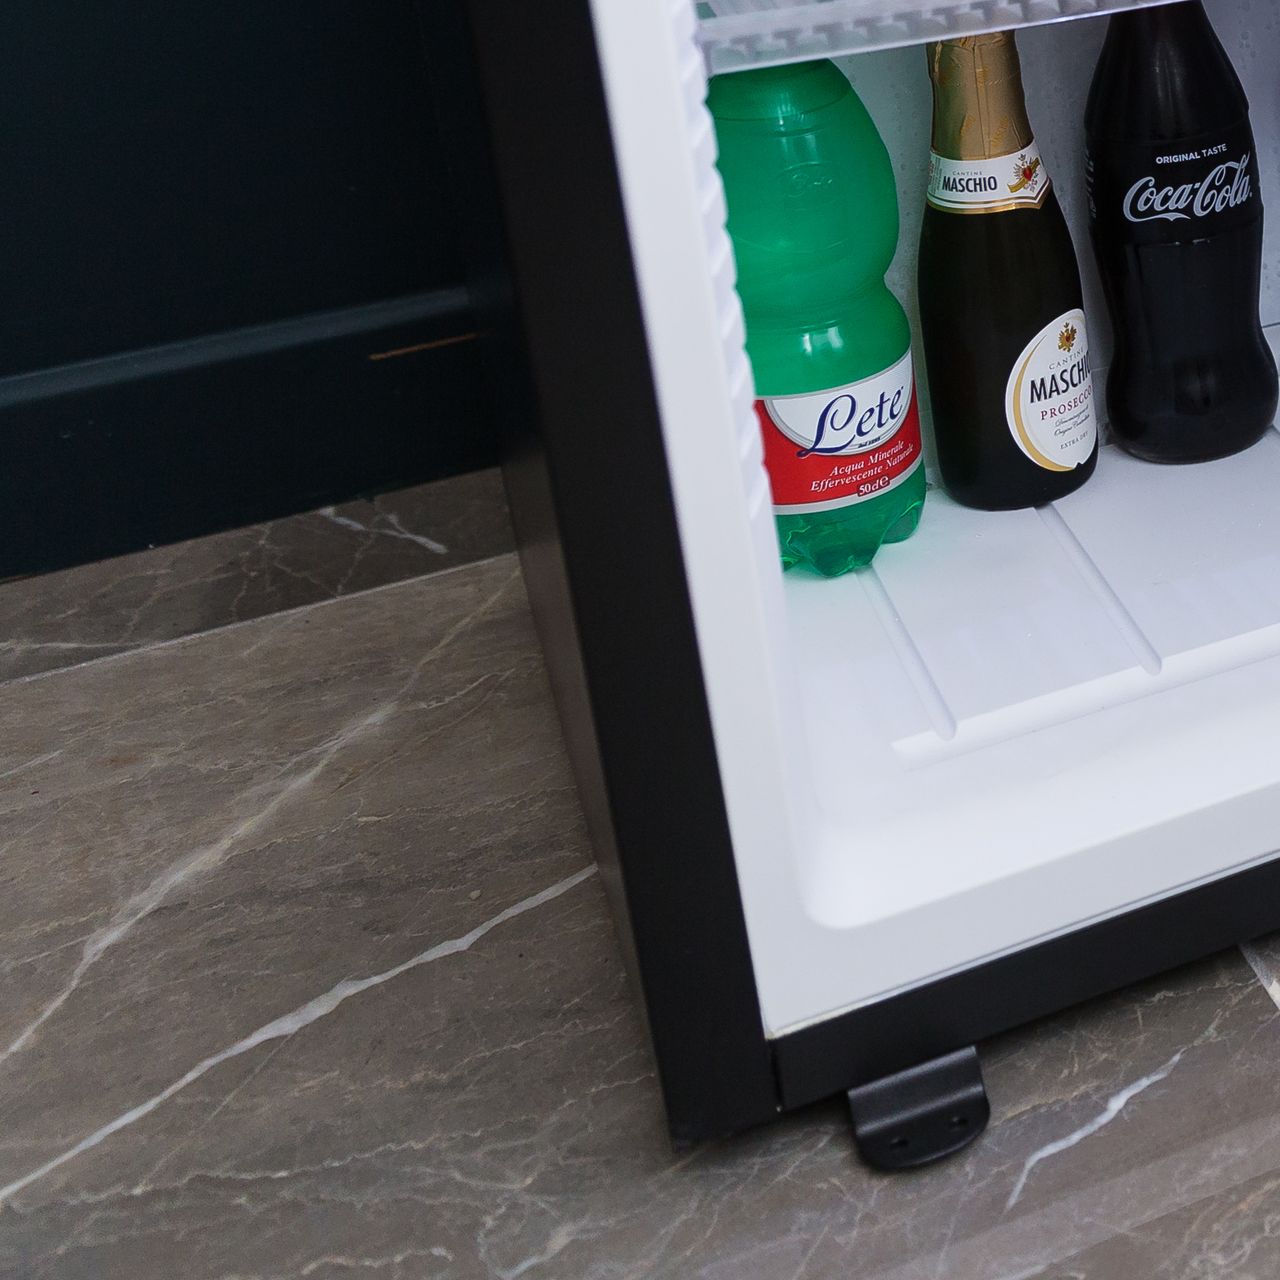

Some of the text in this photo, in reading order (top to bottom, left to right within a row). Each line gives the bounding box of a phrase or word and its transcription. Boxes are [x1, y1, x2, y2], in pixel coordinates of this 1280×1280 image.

[1155, 143, 1228, 164] ORIGINAL TASTE
[942, 175, 997, 193] MASCHIO
[1123, 151, 1252, 222] Coca-Cola
[796, 387, 904, 458] Lete
[810, 465, 883, 493] Effervescente
[885, 442, 914, 471] Naturale
[829, 461, 865, 478] Acqua
[867, 440, 905, 465] Minerale
